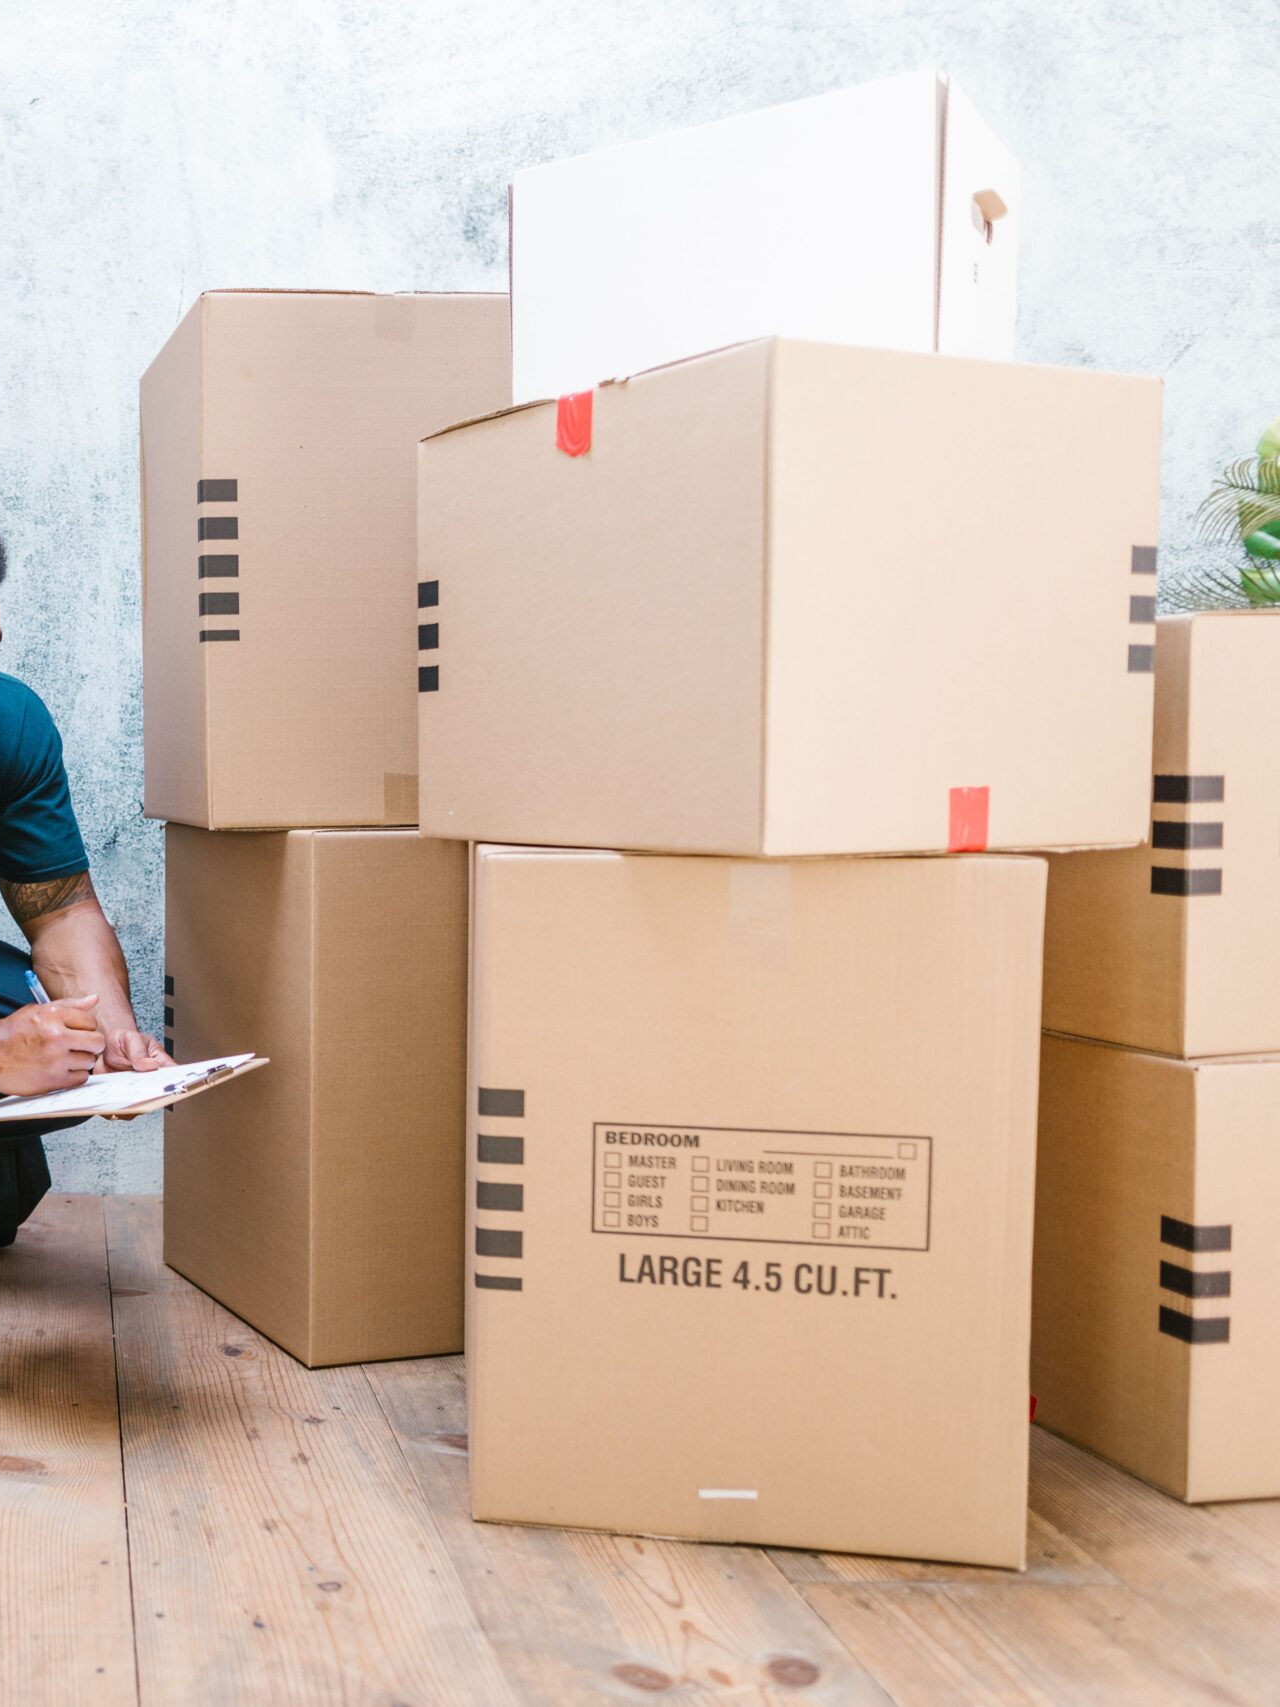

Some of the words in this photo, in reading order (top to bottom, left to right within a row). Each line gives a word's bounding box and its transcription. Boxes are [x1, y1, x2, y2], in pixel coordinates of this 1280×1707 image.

[605, 1130, 700, 1149] BEDROOM
[628, 1155, 676, 1171] MASTER
[716, 1158, 755, 1174] LIVING
[757, 1161, 794, 1176] ROOM
[839, 1165, 906, 1182] BATHROOM
[628, 1174, 667, 1190] GUEST
[716, 1178, 757, 1194] DINING
[759, 1181, 796, 1196] ROOM
[839, 1184, 903, 1201] BASEMENT
[627, 1194, 663, 1209] GIRLS
[716, 1198, 765, 1214] KITCHEN
[627, 1214, 659, 1228] BOYS
[838, 1205, 886, 1221] GARAGE
[838, 1225, 870, 1240] ATTIC
[618, 1253, 723, 1289] LARGE
[732, 1260, 782, 1293] 4.5
